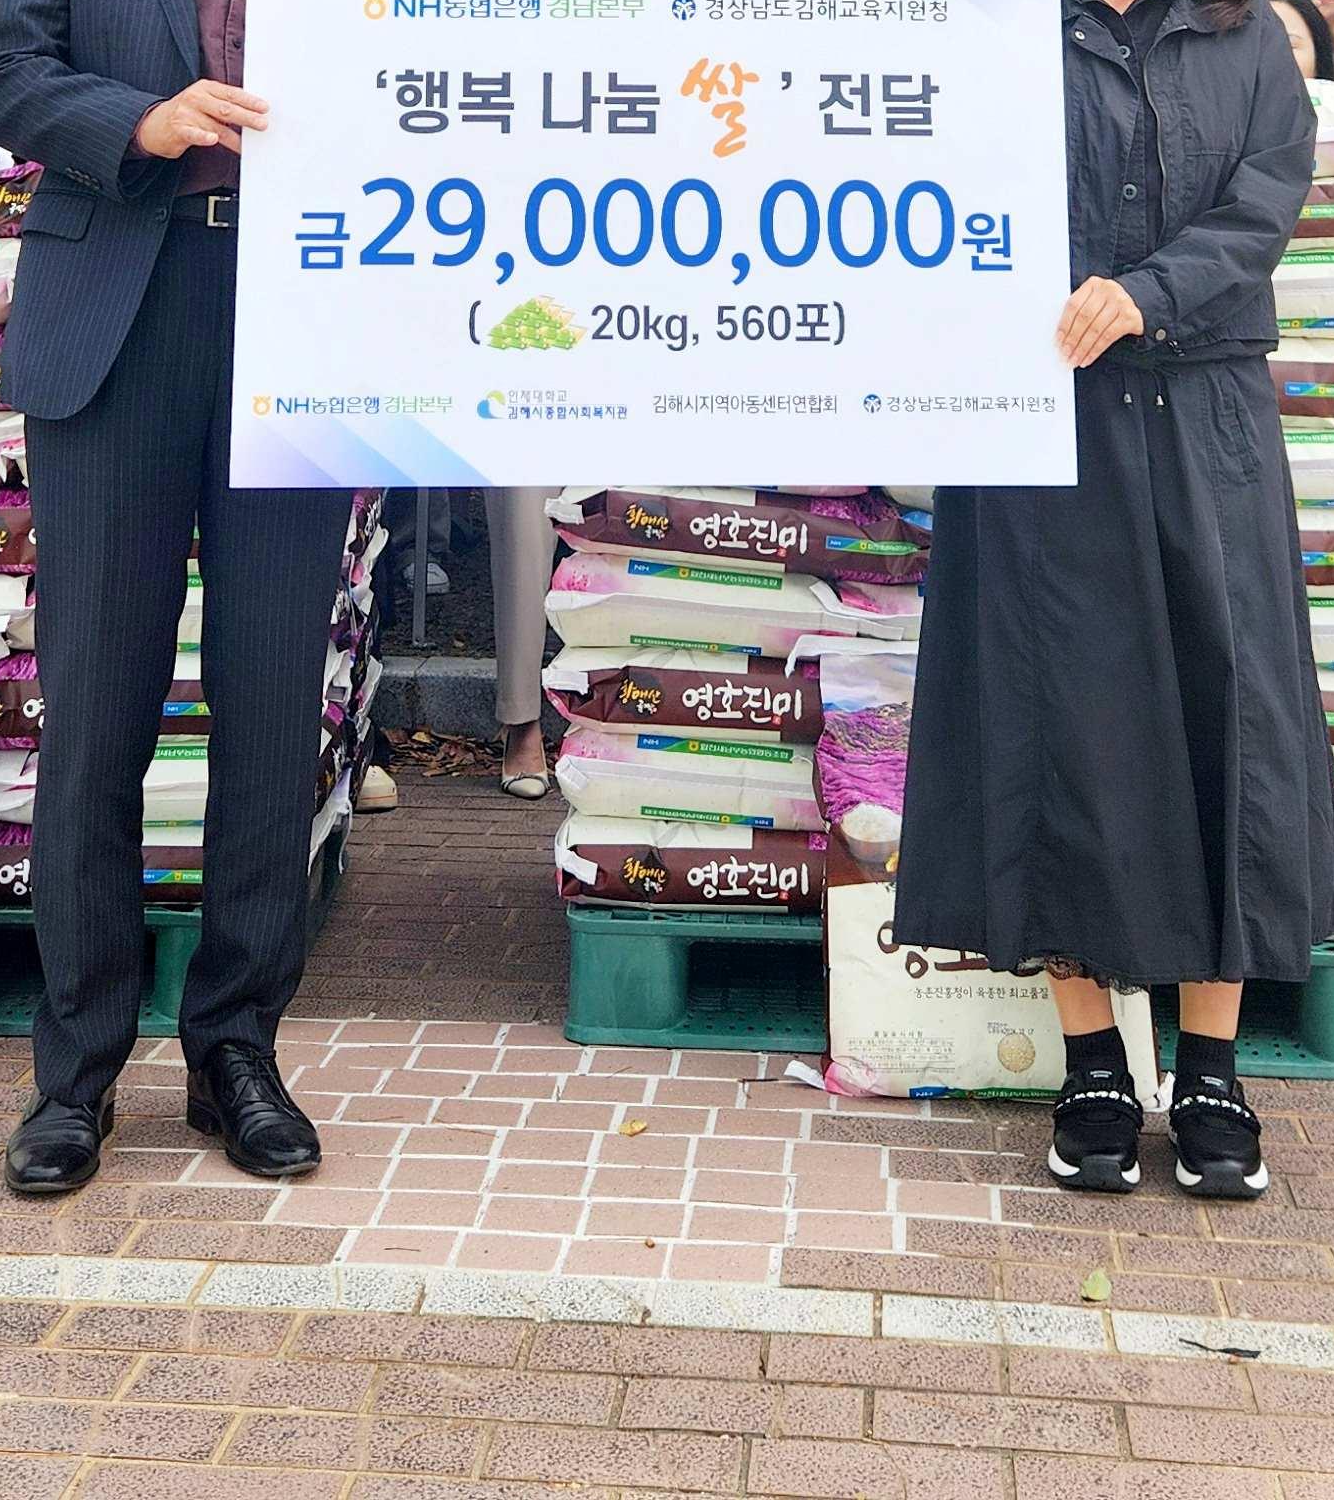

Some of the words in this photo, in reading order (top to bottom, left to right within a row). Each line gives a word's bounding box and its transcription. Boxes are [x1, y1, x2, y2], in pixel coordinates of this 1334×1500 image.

[540, 68, 661, 134] 나눔
[818, 70, 940, 137] 전달
[293, 177, 1014, 285] 금29,000,000원
[590, 304, 700, 352] 20kg,
[275, 396, 380, 415] NH농협은행
[383, 395, 453, 415] 경남본부
[507, 405, 629, 421] 김해시종합사회복지관
[651, 394, 838, 415] 김해시지역아동센터연합회
[885, 396, 1057, 414] 경상남도김해교육지원청
[626, 502, 669, 531] 황매산
[689, 509, 811, 555] 영호진미
[633, 564, 650, 573] NH
[619, 679, 662, 708] 황매산
[681, 677, 803, 724] 영호진미
[642, 737, 661, 748] NH
[622, 855, 666, 883] 황매산
[685, 854, 811, 900] 영호진미
